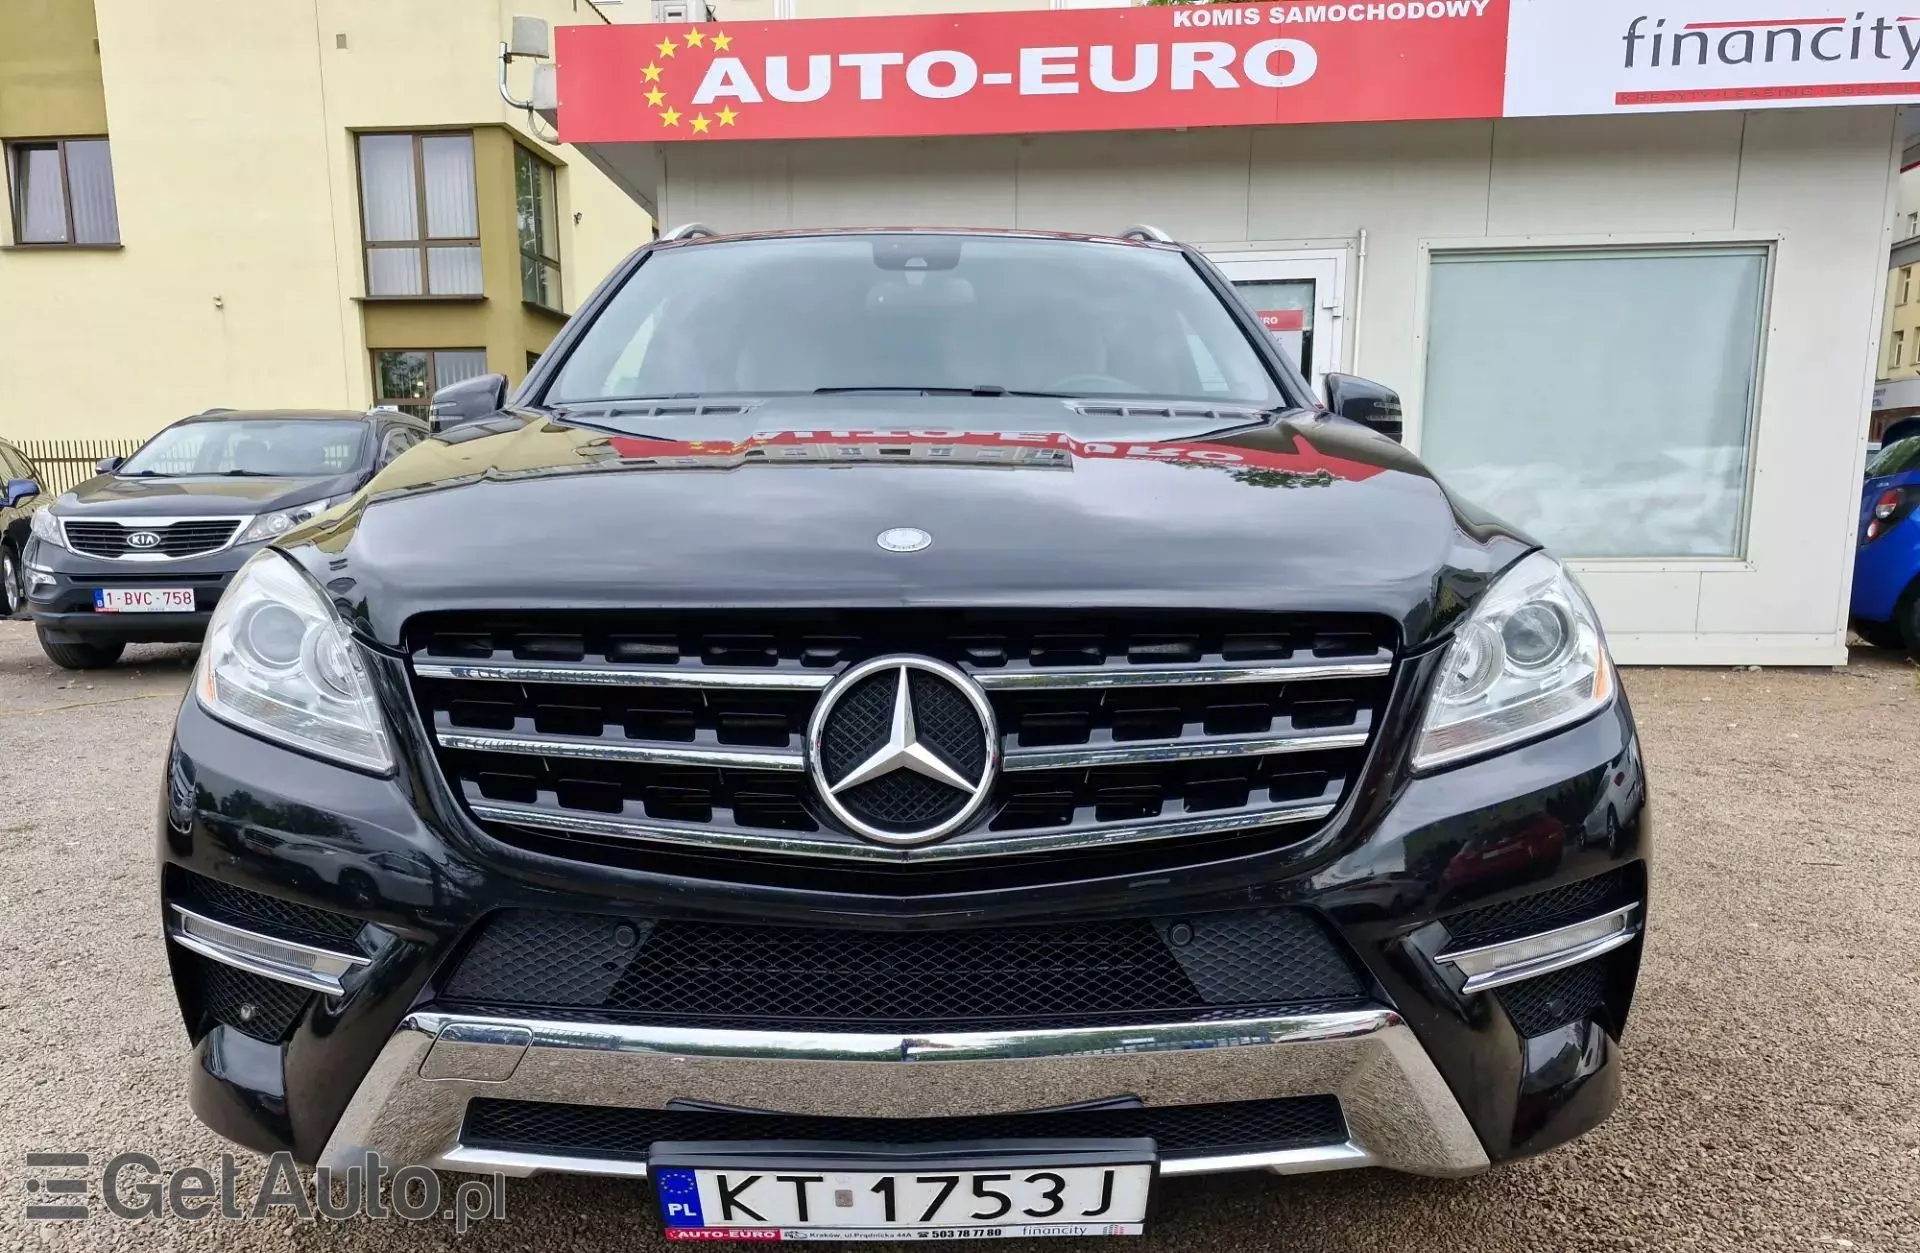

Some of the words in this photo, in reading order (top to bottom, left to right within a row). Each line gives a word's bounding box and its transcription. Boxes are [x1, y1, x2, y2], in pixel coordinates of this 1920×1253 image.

[1173, 7, 1260, 28] KOMIS
[1269, 0, 1488, 24] SAMOCHODOWY
[1622, 12, 1920, 70] financity
[691, 38, 1318, 104] AUTO-EURO
[1723, 86, 1812, 99] LEASING
[132, 535, 154, 544] KIA
[716, 1174, 824, 1222] KT
[668, 1203, 697, 1216] PL
[678, 1229, 776, 1239] AUTO-EURO
[932, 1230, 954, 1238] 503
[957, 1229, 970, 1237] 78
[973, 1229, 985, 1237] 77
[986, 1228, 1002, 1237] 80
[1023, 1226, 1088, 1236] financity
